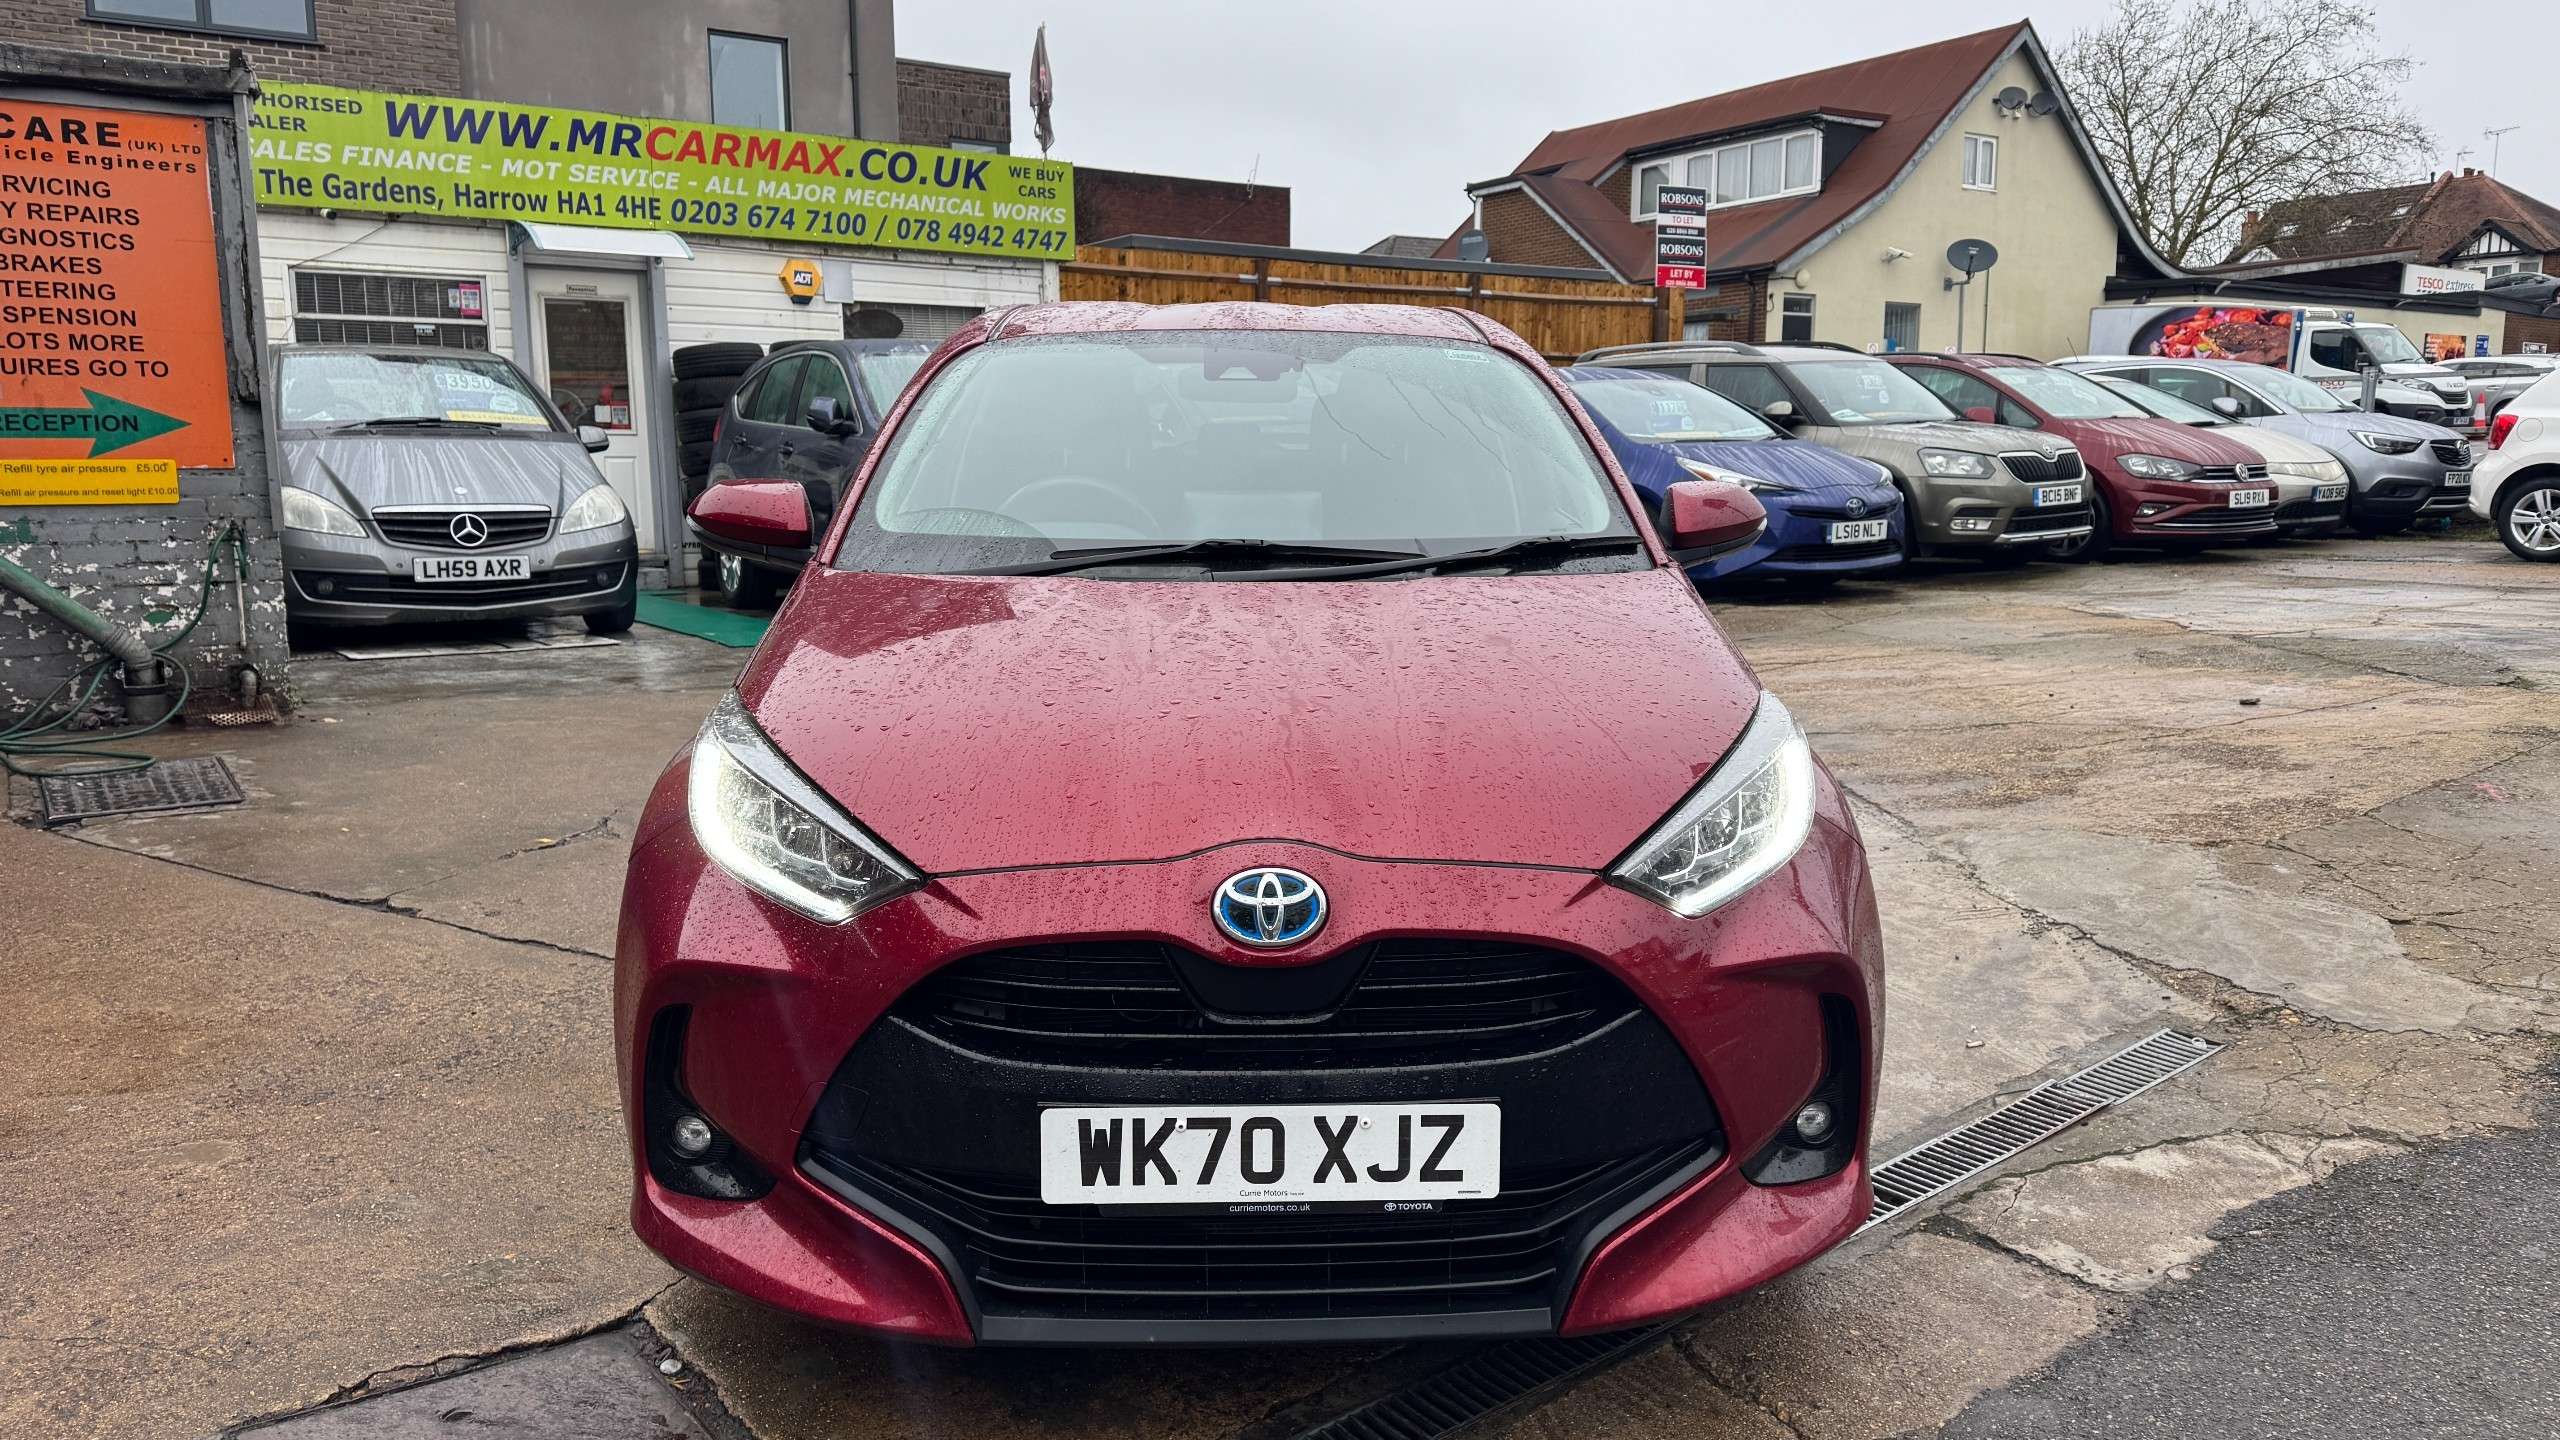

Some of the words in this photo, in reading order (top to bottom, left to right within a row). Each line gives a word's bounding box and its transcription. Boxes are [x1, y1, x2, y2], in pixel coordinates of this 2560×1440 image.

[253, 92, 363, 115] HORISED
[0, 112, 122, 148] CARE
[128, 140, 164, 153] (UK)
[172, 143, 202, 155] LTD
[385, 100, 992, 192] WWW.MRCARMAX.CO.UK
[67, 150, 197, 174] Engineers
[1008, 165, 1031, 180] WE
[1037, 168, 1064, 182] BUY
[2, 174, 111, 199] RVICING
[342, 144, 473, 174] FINANCE
[501, 158, 562, 182] MOT
[568, 163, 681, 190] SERVICE
[705, 175, 749, 196] ALL
[756, 179, 836, 204] MAJOR
[844, 187, 985, 217] MECHANICAL
[992, 202, 1066, 224] WORKS
[1018, 184, 1056, 199] CARS
[1661, 192, 1704, 206] ROBSONS
[27, 202, 140, 226] REPAIRS
[259, 168, 313, 197] The
[322, 173, 444, 211] Gardens,
[454, 182, 548, 213] Harrow
[557, 190, 605, 217] HA1
[615, 197, 661, 221] 4HE
[671, 198, 738, 226] 0203
[747, 205, 795, 231] 674
[806, 209, 867, 236] 7100
[896, 217, 940, 242] 078
[948, 222, 1004, 248] 4942
[1012, 228, 1068, 252] 4747
[1672, 215, 1681, 224] TO
[1683, 216, 1694, 225] LET
[0, 227, 135, 251] GNOSTICS
[1660, 243, 1704, 257] ROBSONS
[0, 254, 102, 275] BRAKES
[1670, 268, 1682, 279] LET
[1684, 269, 1695, 279] BY
[794, 272, 812, 285] ADT
[2417, 276, 2444, 290] TESCO
[0, 279, 116, 300] TEERING
[3, 306, 137, 327] SPENSION
[0, 331, 60, 351] OTS
[69, 333, 145, 353] MORE
[0, 358, 80, 376] UIRES
[89, 360, 127, 377] GO
[135, 360, 169, 378] TO
[4, 463, 32, 473] Refill
[37, 464, 57, 475] tyre
[61, 463, 74, 473] air
[78, 464, 127, 475] pressure
[0, 488, 21, 497] Refill
[24, 487, 36, 497] air
[38, 487, 80, 498] pressure
[82, 487, 99, 496] and
[102, 487, 124, 496] reset
[127, 485, 146, 498] light
[2041, 489, 2062, 504] BC15
[2063, 487, 2079, 502] BNF
[1834, 522, 1860, 540] LS18
[1862, 521, 1885, 538] NLT
[422, 560, 477, 578] LH59
[485, 559, 521, 577] AXR
[1078, 1116, 1286, 1187] WK70
[1313, 1114, 1465, 1184] XJZ
[1263, 1189, 1288, 1197] Motors
[1229, 1202, 1311, 1212] curriemotors.co.uk
[1397, 1202, 1433, 1211] TOYOTA
